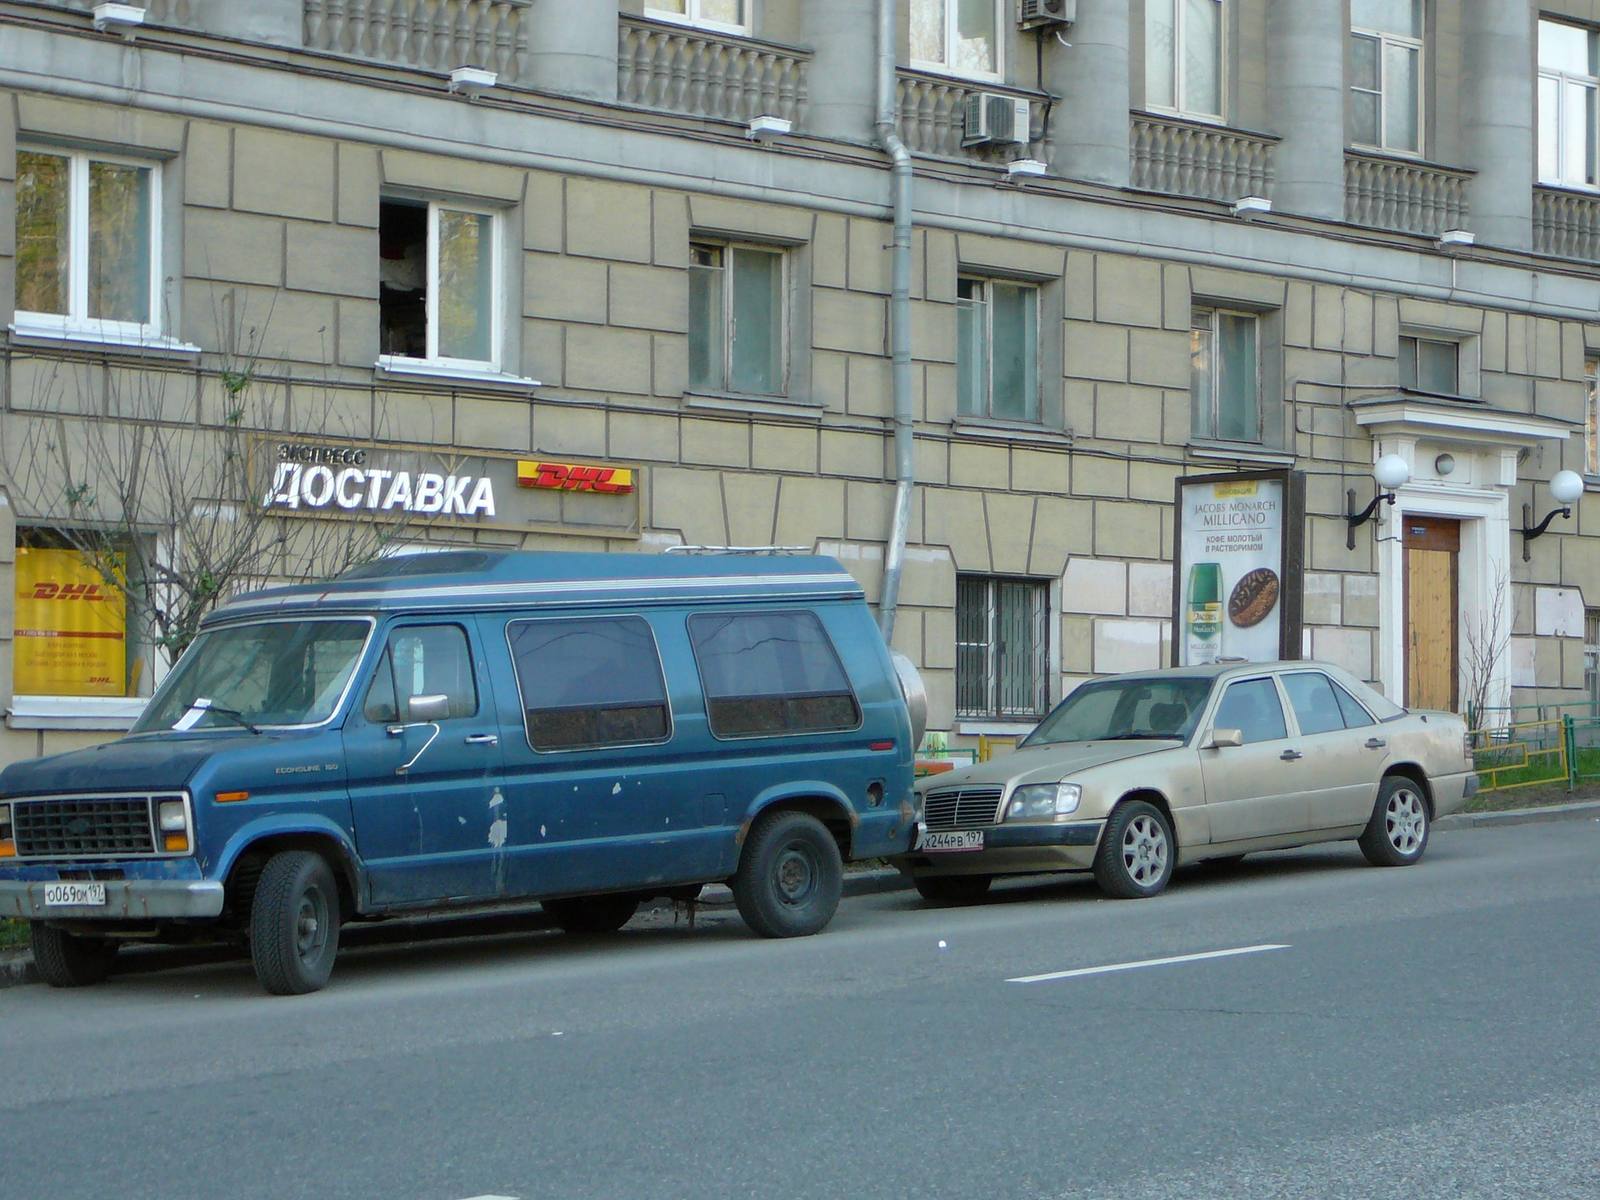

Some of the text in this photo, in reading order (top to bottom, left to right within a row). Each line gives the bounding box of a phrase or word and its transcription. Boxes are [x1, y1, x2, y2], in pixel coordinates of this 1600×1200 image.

[534, 463, 617, 493] DHL
[263, 462, 497, 517] ДОСТАВКА
[1195, 501, 1276, 514] JACOBS MONARCH
[1203, 512, 1266, 526] MILLICANO
[1206, 533, 1263, 544] КОФЕ МОЛОТЫЙ
[1211, 543, 1264, 552] РАСТВОРИМОМ
[33, 582, 104, 601] DHL
